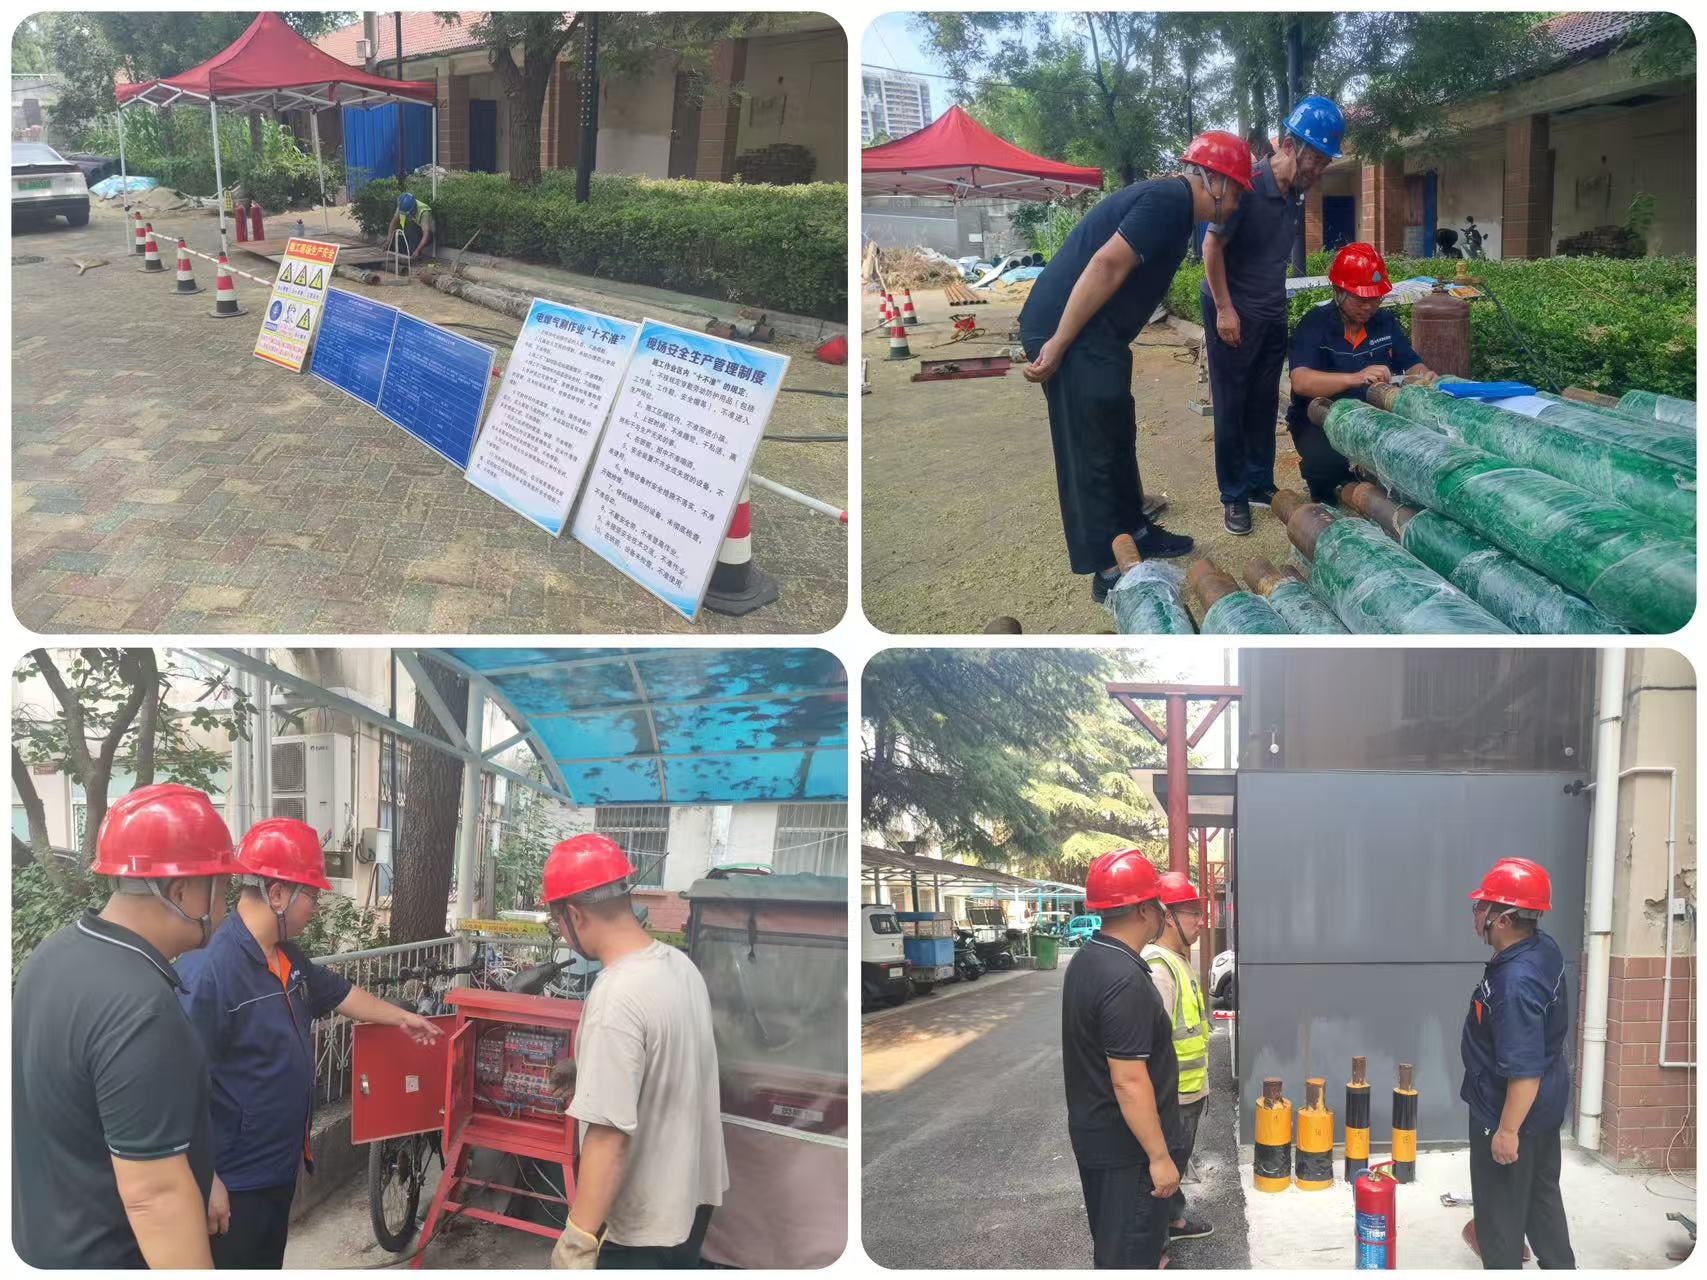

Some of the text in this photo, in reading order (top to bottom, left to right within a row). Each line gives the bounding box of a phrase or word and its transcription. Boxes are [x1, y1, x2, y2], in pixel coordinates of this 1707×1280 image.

[646, 337, 768, 386] 现场安全生产管理制度
